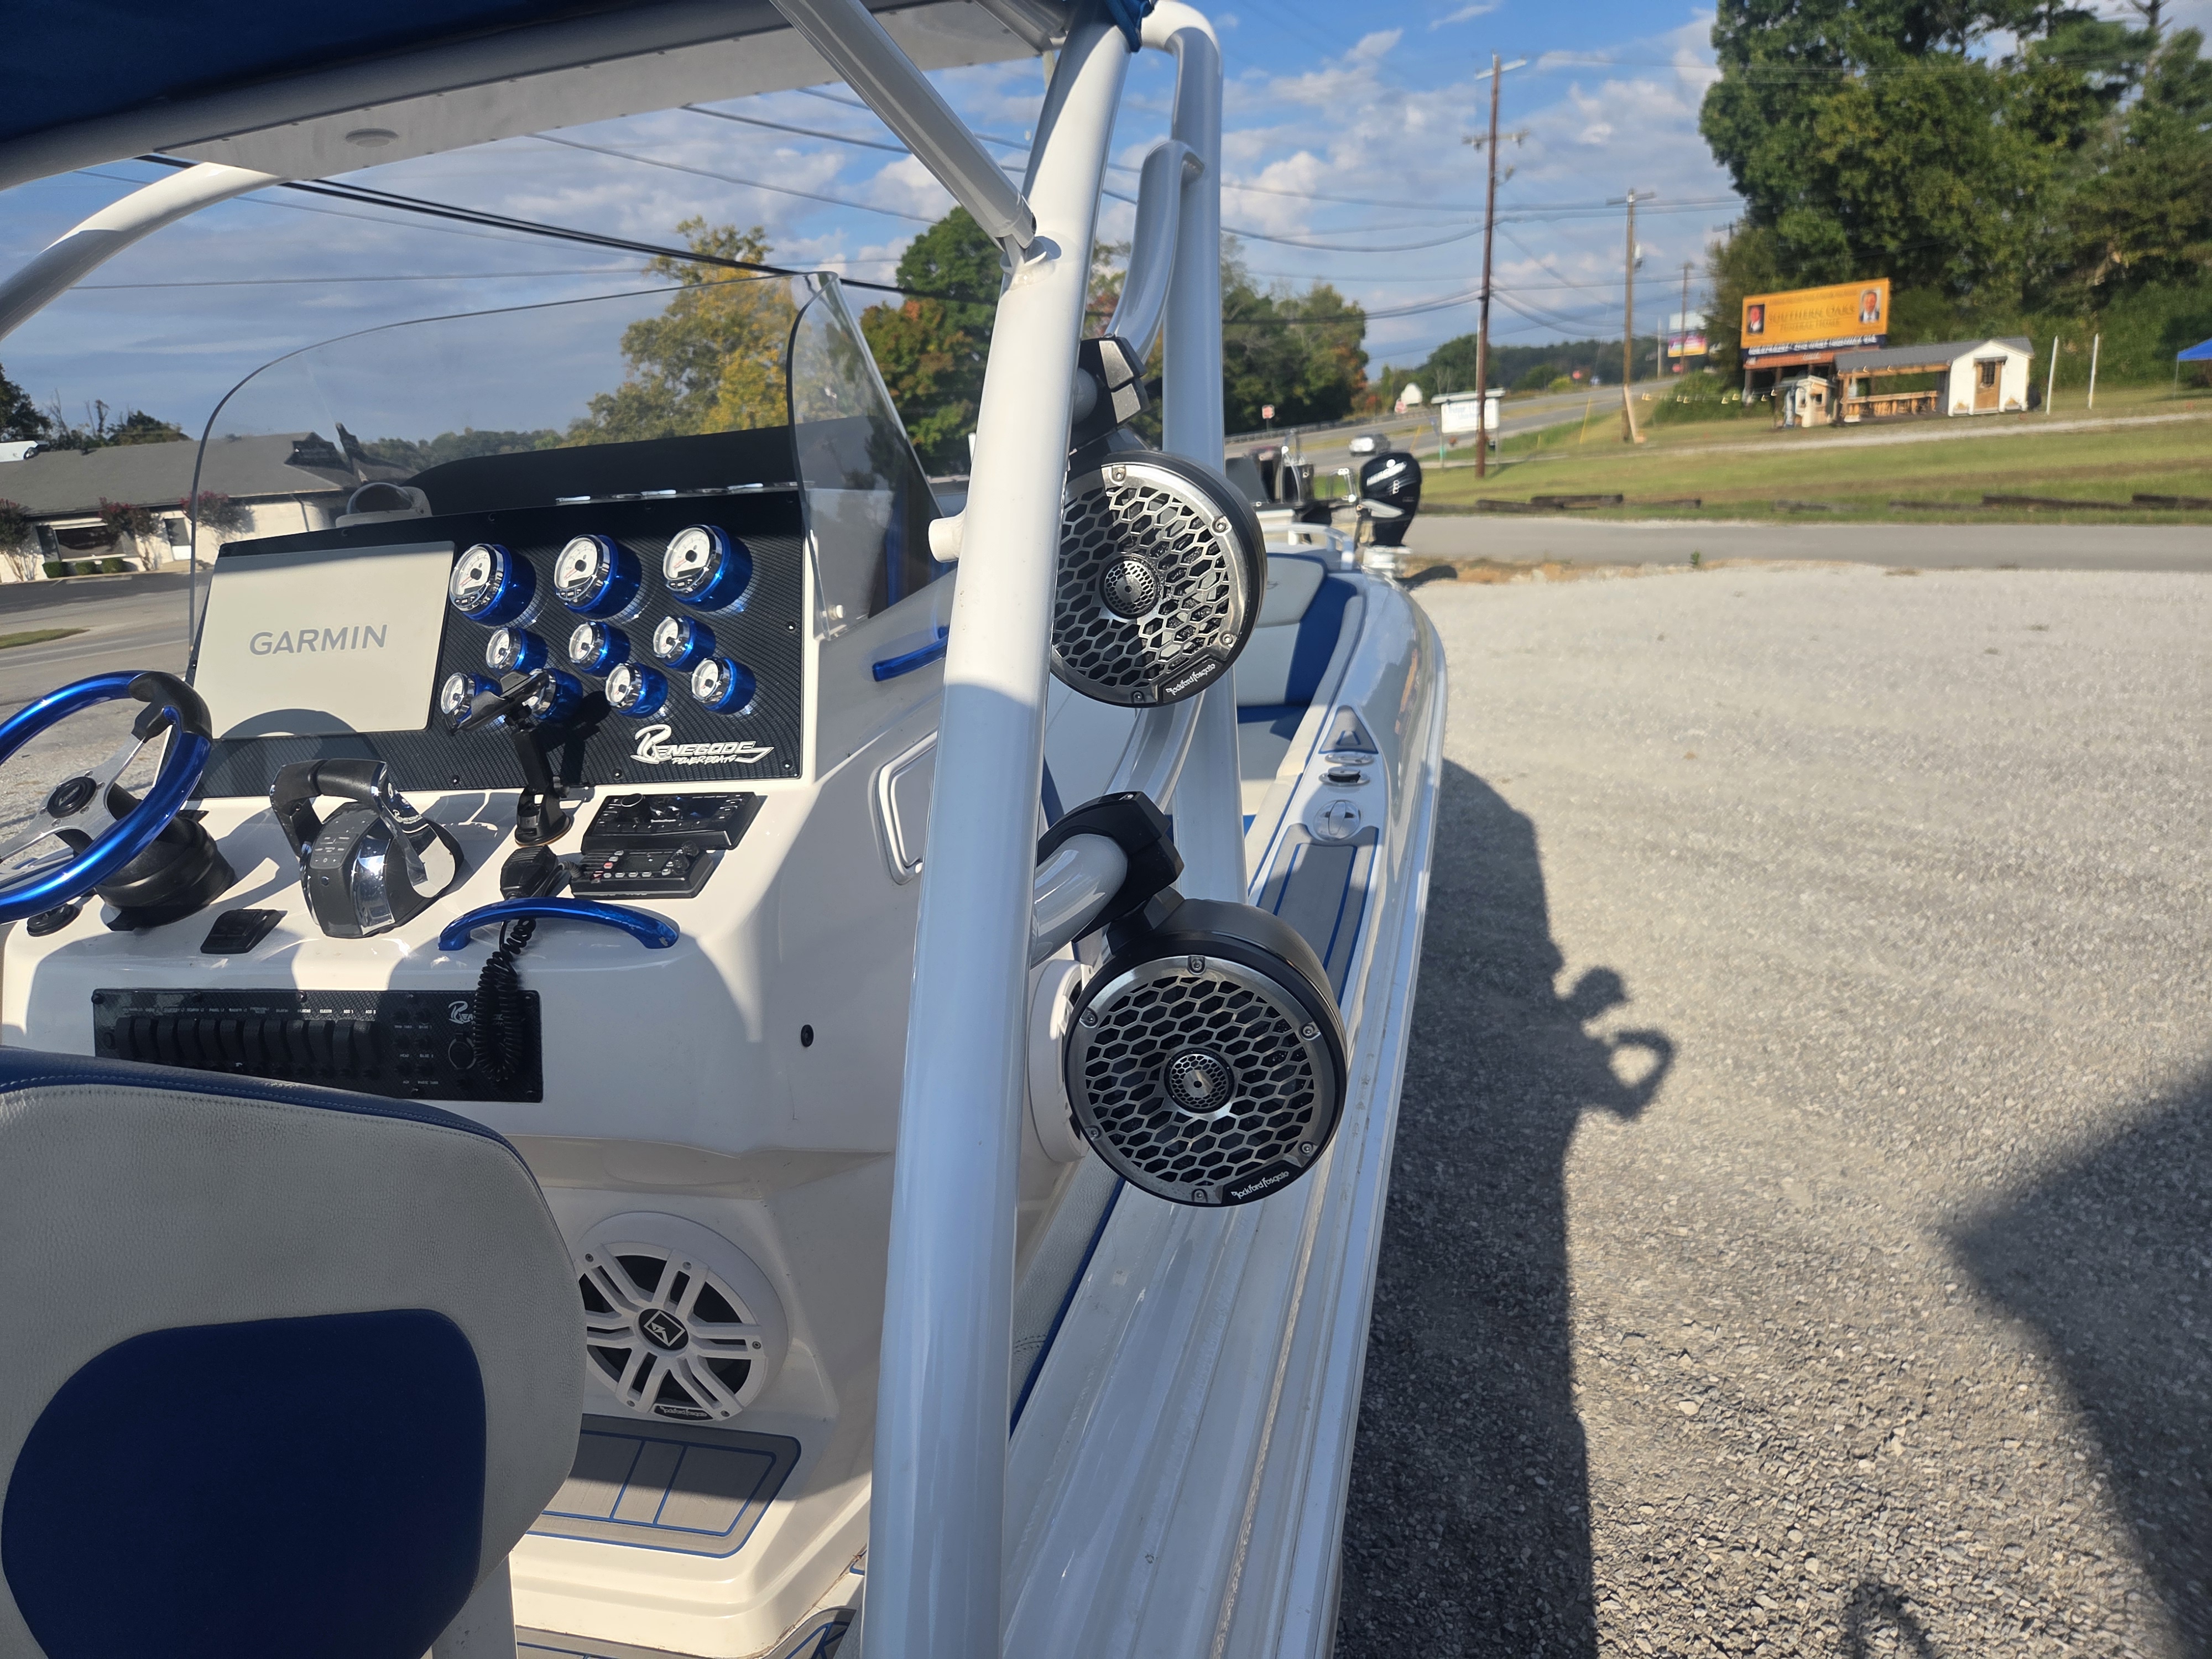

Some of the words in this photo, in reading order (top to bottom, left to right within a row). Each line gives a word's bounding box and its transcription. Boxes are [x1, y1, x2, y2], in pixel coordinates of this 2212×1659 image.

[250, 624, 387, 655] GARMIN
[630, 724, 774, 764] RENEGADE
[1230, 1181, 1265, 1199] Rockford
